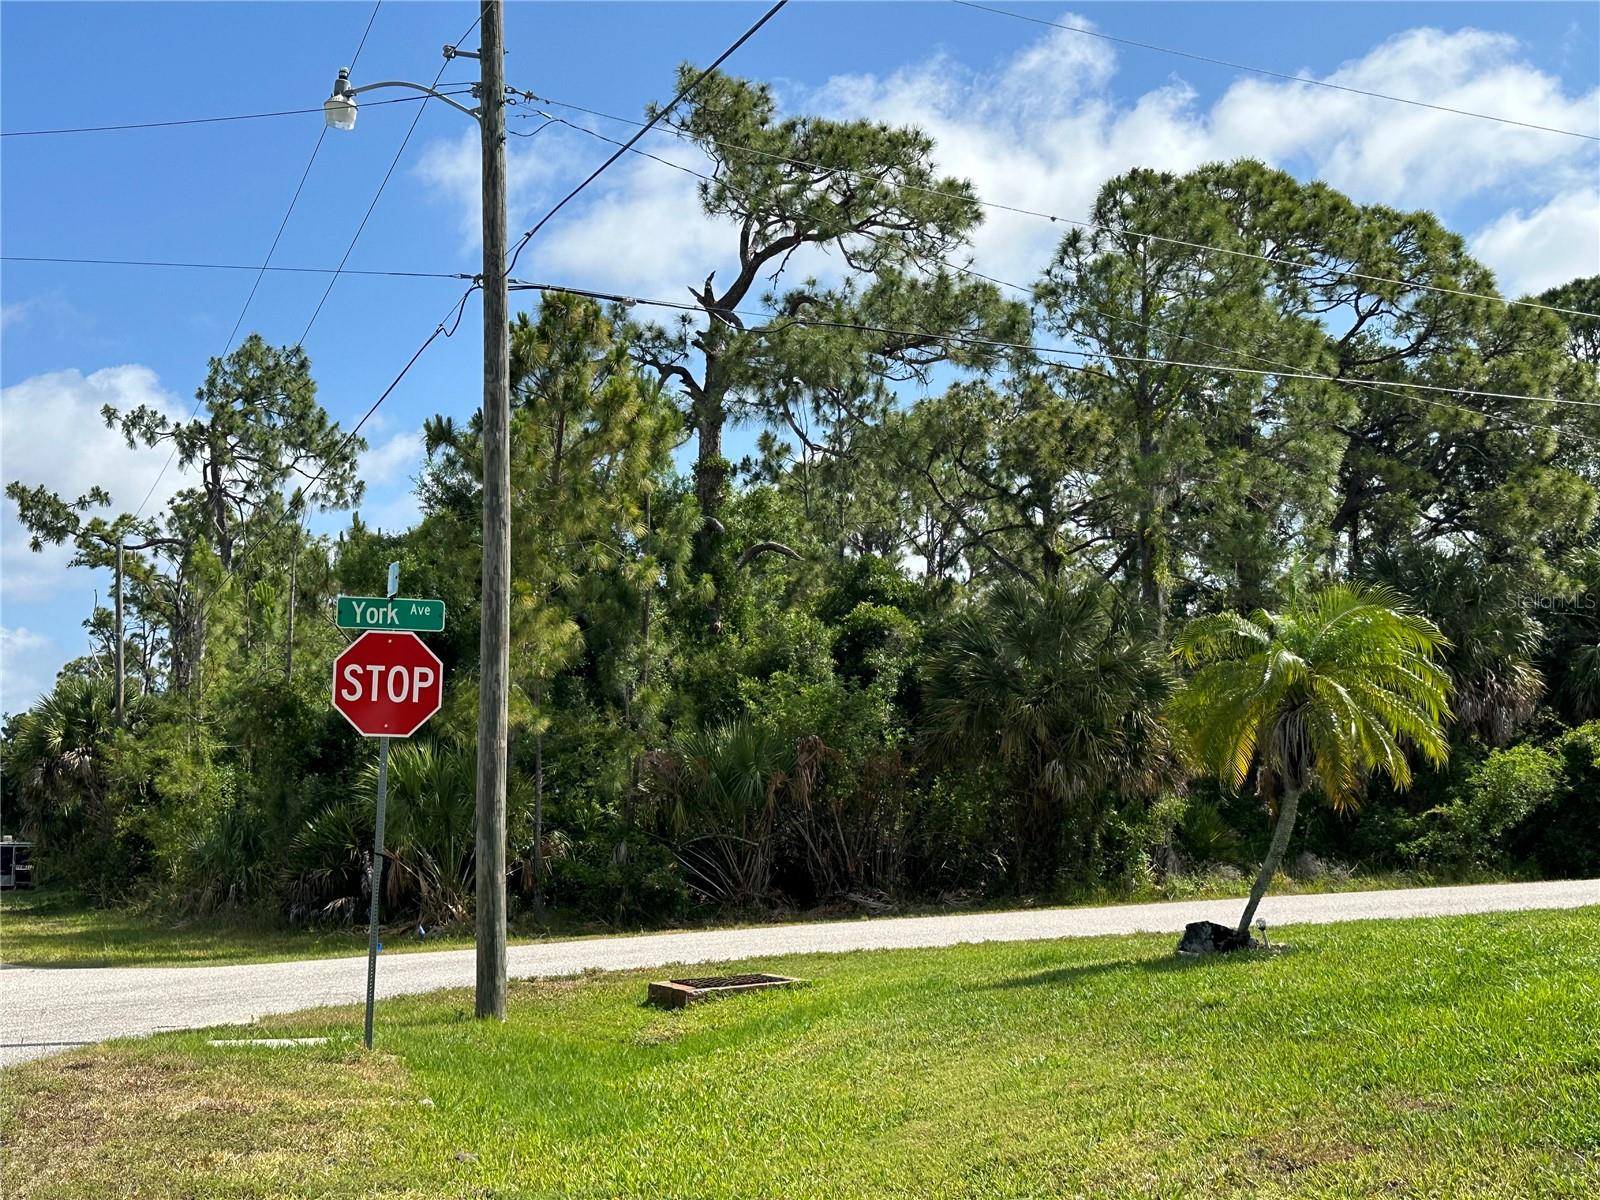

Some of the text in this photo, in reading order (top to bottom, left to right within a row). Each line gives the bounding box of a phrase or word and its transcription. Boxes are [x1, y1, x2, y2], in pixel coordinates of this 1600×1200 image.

[352, 601, 431, 625] York Ave
[341, 664, 434, 703] STOP
